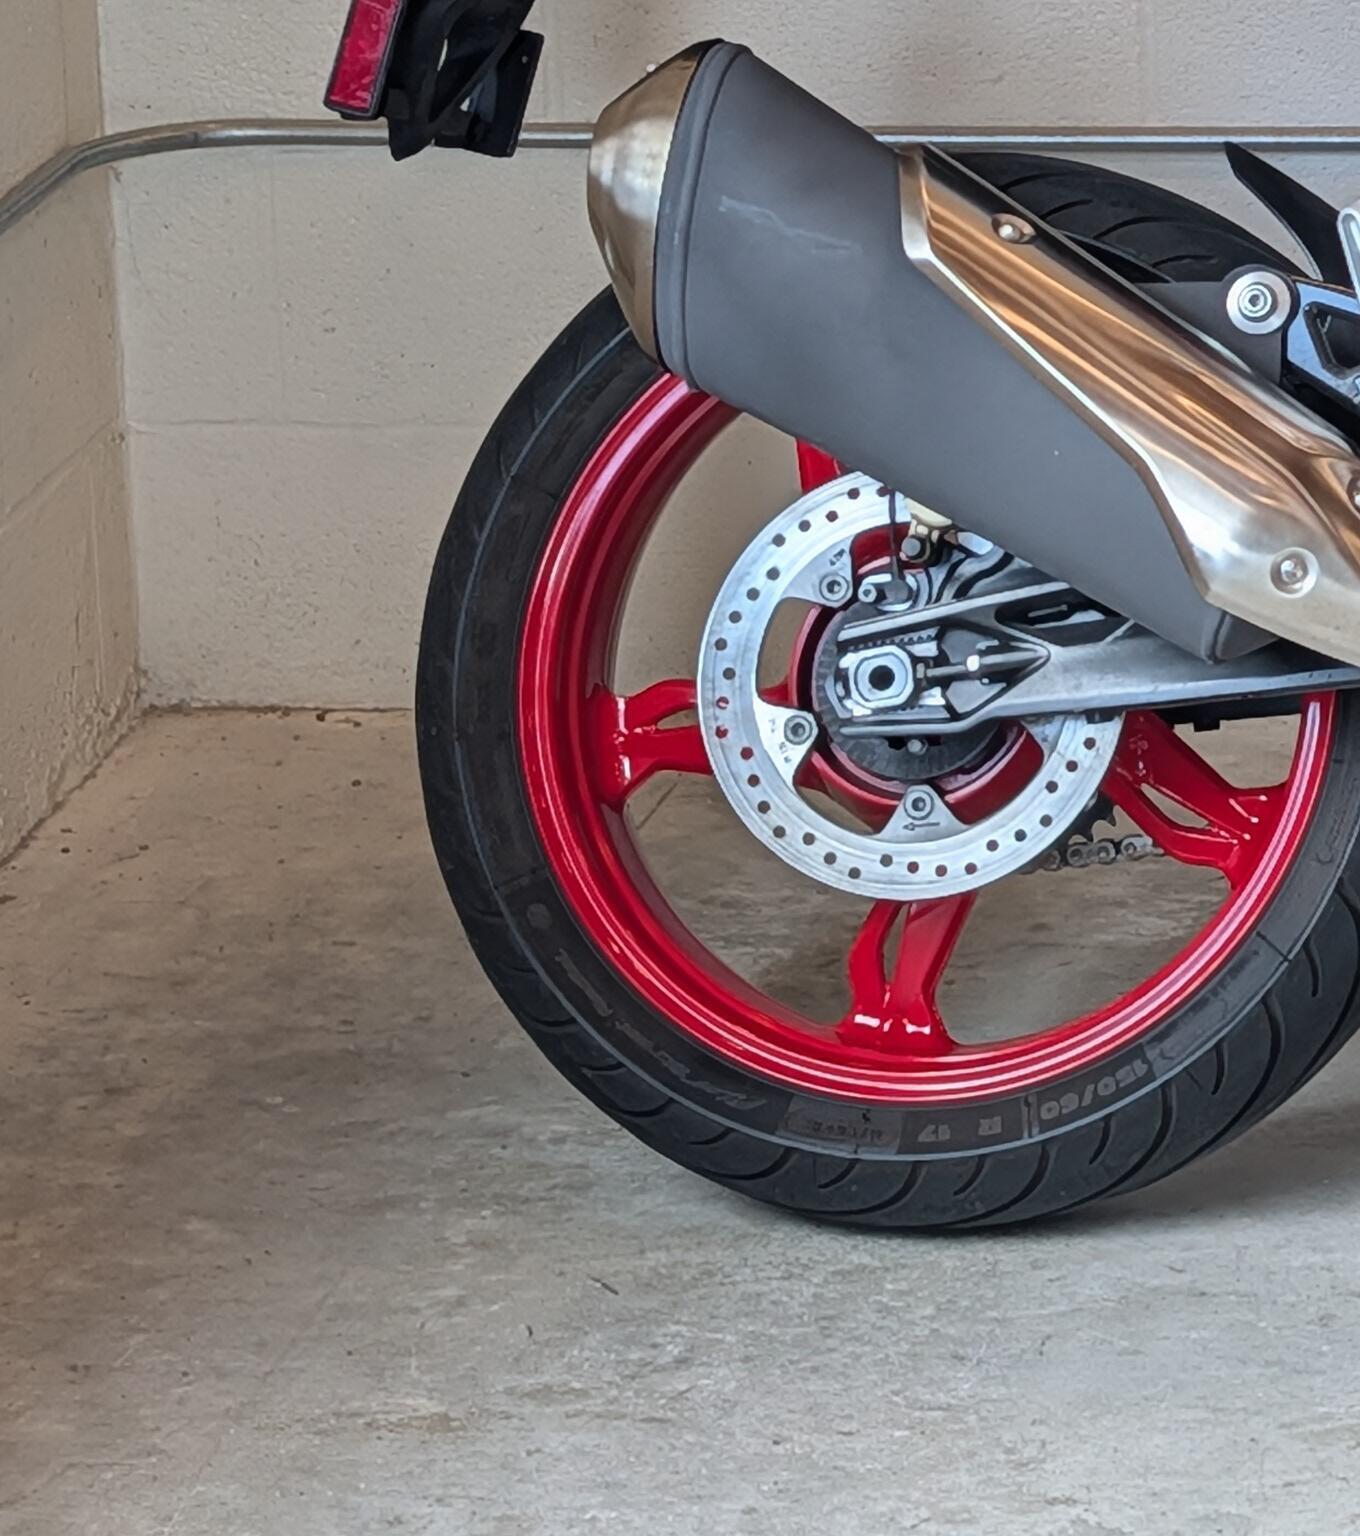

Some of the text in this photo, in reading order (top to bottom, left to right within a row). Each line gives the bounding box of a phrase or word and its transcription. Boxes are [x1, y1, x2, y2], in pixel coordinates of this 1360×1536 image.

[917, 1059, 1149, 1142] 150/60 R 17
